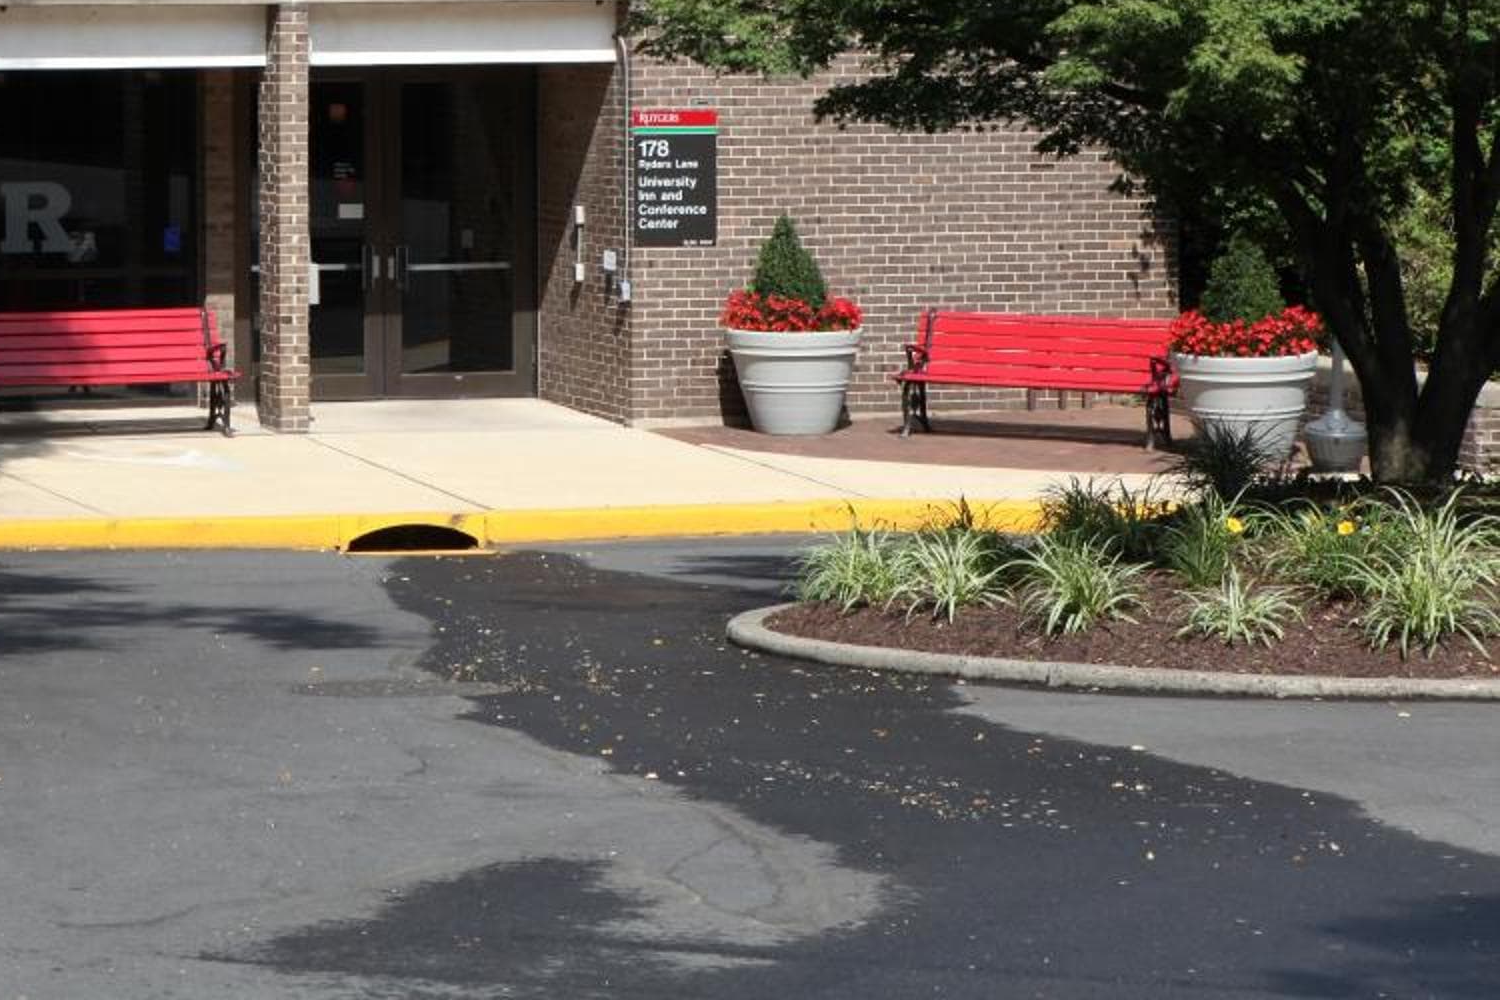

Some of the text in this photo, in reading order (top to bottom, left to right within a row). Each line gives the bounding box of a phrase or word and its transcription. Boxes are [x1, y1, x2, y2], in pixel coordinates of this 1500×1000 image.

[638, 139, 669, 157] 178
[638, 160, 698, 170] Ryders Lane
[638, 176, 697, 190] University
[638, 190, 683, 201] Inn and
[638, 204, 707, 216] Conference
[0, 181, 75, 254] R
[638, 218, 679, 229] Center
